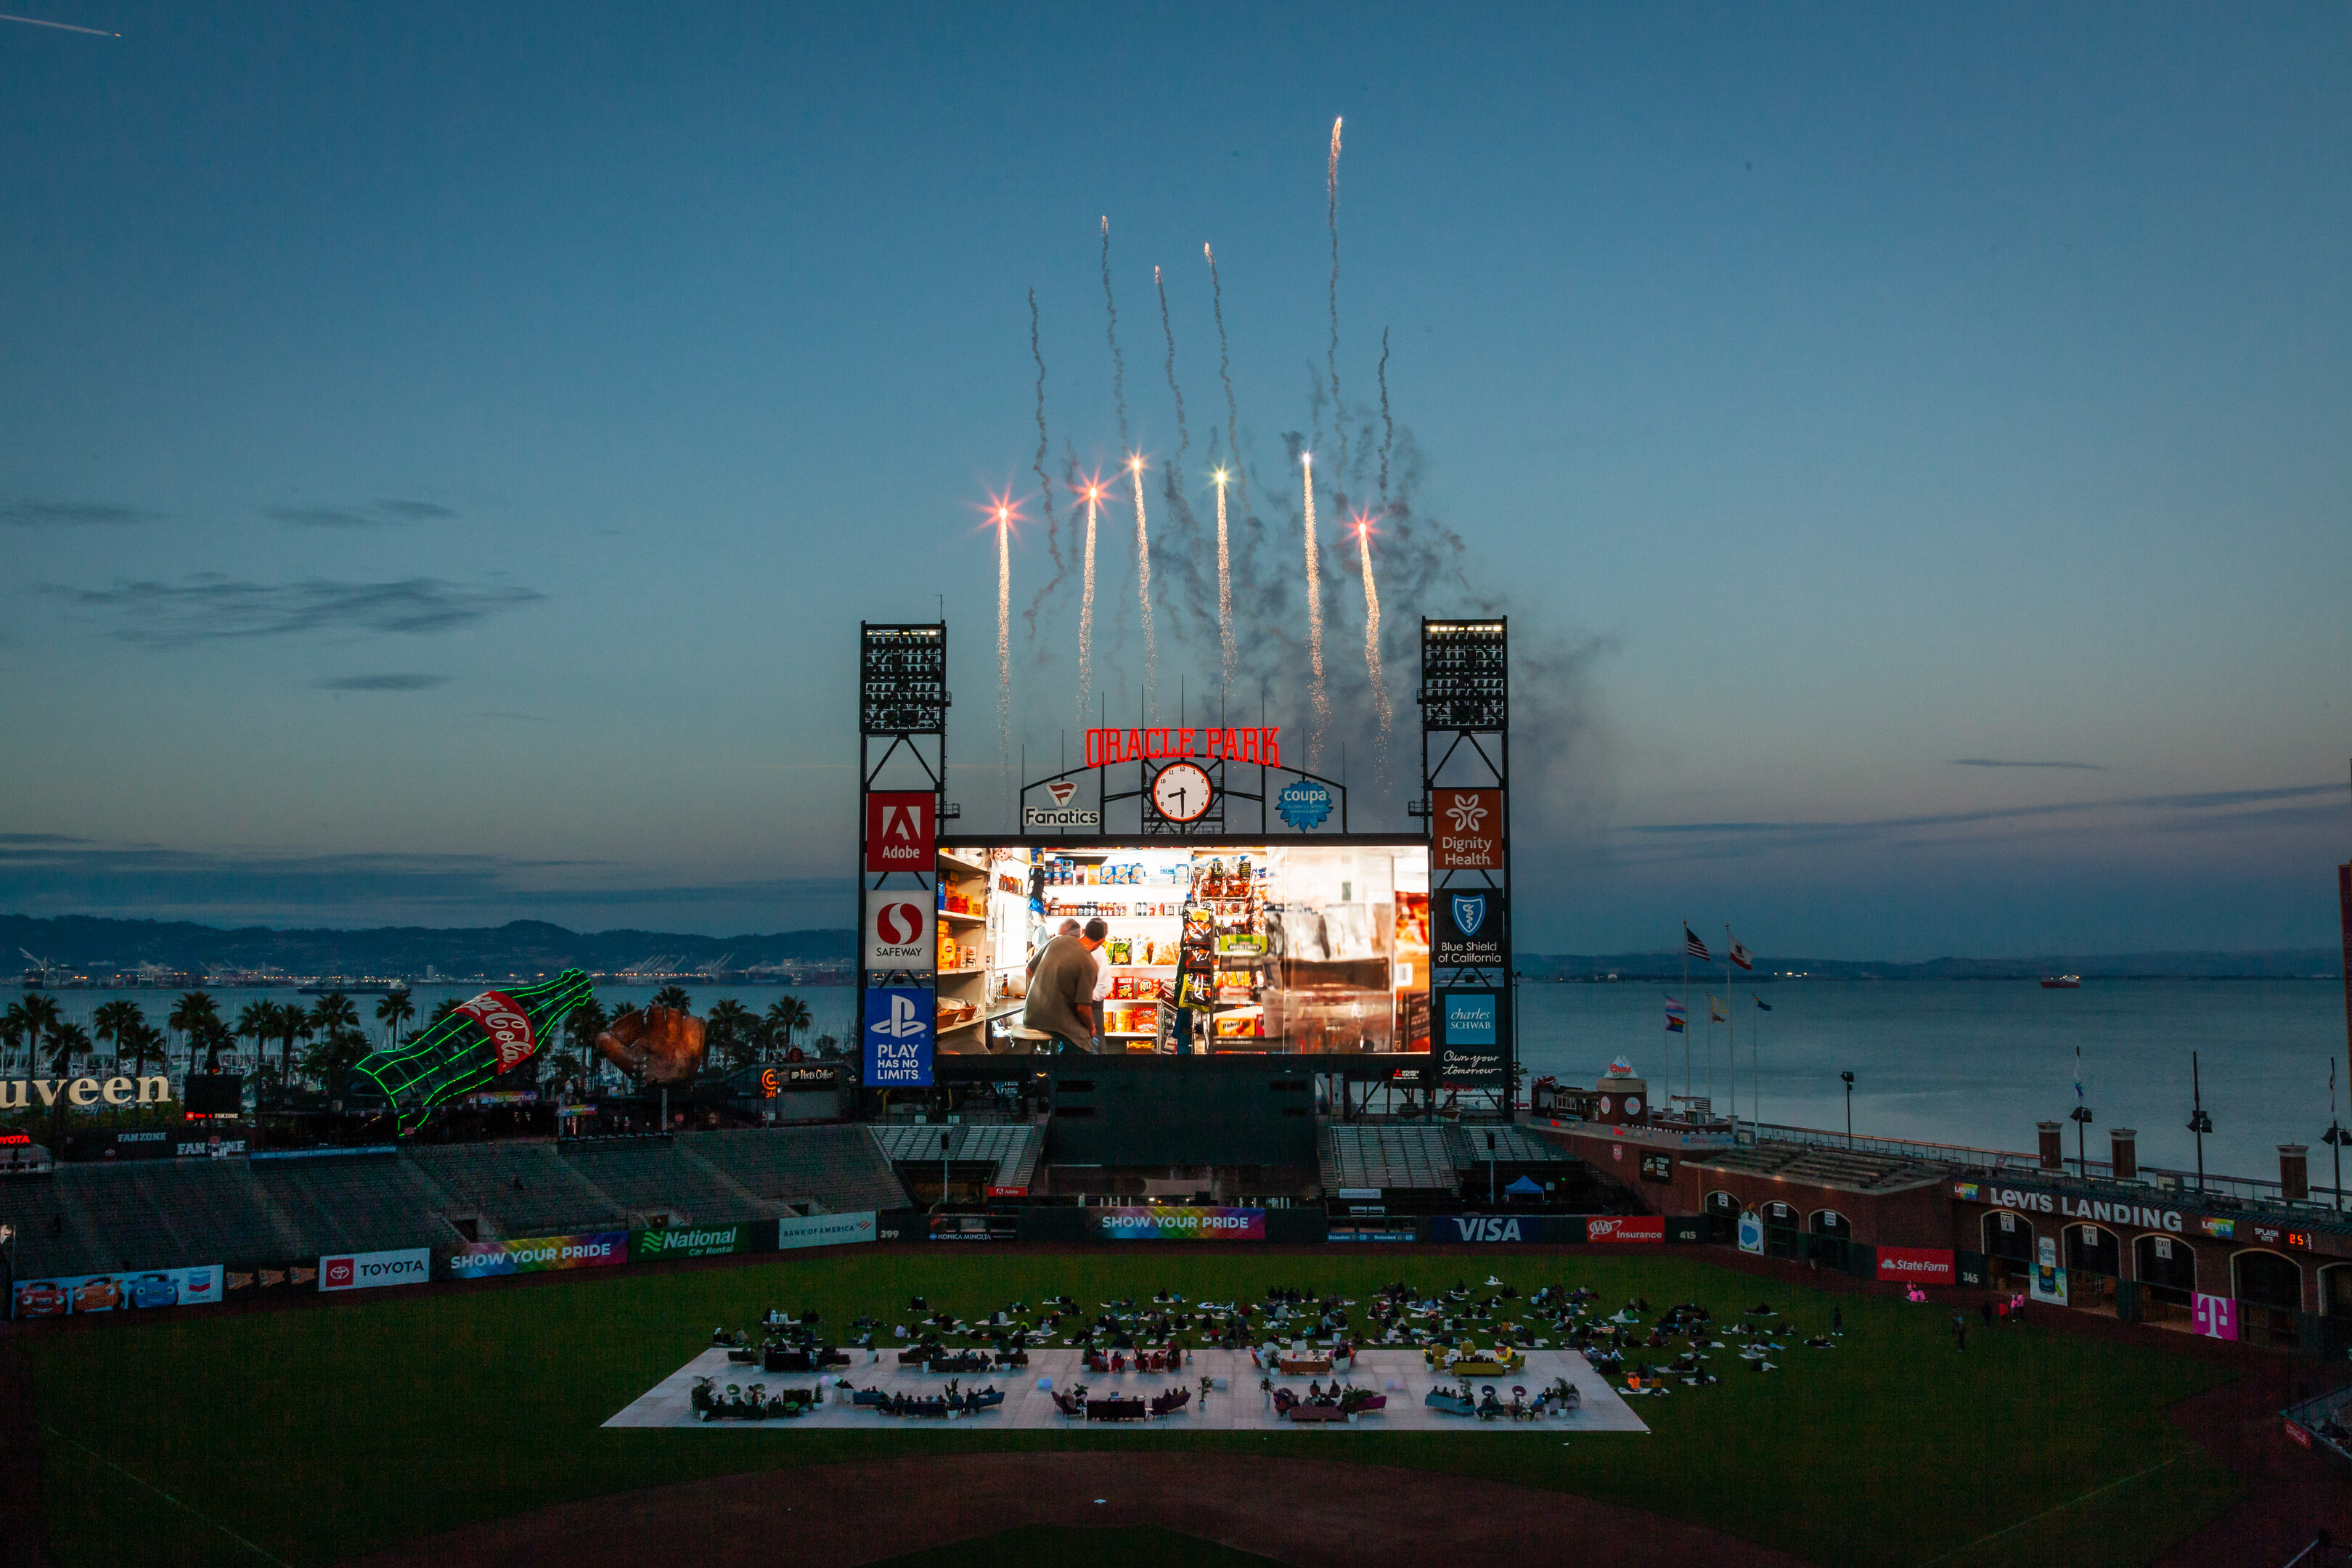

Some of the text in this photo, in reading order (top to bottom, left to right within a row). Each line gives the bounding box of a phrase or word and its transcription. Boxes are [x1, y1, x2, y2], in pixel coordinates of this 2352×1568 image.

[1086, 727, 1281, 768] ORACLE PARK
[1283, 790, 1327, 804] coupa
[1025, 808, 1098, 825] Fanatics
[1442, 836, 1492, 852] Dignity
[882, 844, 920, 859] Adobe
[1445, 852, 1490, 865] Health
[876, 947, 922, 957] SAFEWAY
[1442, 942, 1497, 952] Blue Shield
[1438, 953, 1501, 963] of California
[1141, 981, 1151, 990] RITZ
[1450, 1008, 1490, 1020] charles
[1450, 1021, 1491, 1029] SCHWAB
[878, 1044, 919, 1058] PLAY
[878, 1059, 919, 1069] HAS NO
[1443, 1050, 1500, 1068] Own your
[816, 1069, 834, 1079] Coffee
[1442, 1063, 1502, 1075] tomorrow
[1609, 1063, 1632, 1073] Coors
[0, 1076, 172, 1108] uveen
[1442, 1081, 1503, 1092] Coors LIGHT
[118, 1132, 167, 1143] FAN ZONE
[176, 1142, 206, 1156] FAN
[2062, 1196, 2182, 1233] LANDING
[1102, 1216, 1249, 1228] SHOW YOUR PRIDE
[1591, 1221, 1612, 1233] AAA
[819, 1225, 854, 1234] AMERICA
[880, 1230, 899, 1238] 399
[1452, 1217, 1522, 1241] VISA
[1617, 1230, 1662, 1239] Insurance
[1679, 1230, 1696, 1239] 415
[2084, 1227, 2096, 1236] EXIT
[2254, 1228, 2279, 1238] SPLASH
[663, 1226, 738, 1249] National
[2157, 1238, 2170, 1247] EXIT
[2290, 1233, 2303, 1245] 85
[450, 1243, 611, 1269] SHOW YOUR PRIDE
[689, 1245, 734, 1257] Car Rental
[361, 1260, 424, 1277] TOYOTA
[1962, 1272, 1979, 1283] 365
[2197, 1293, 2227, 1339] T
